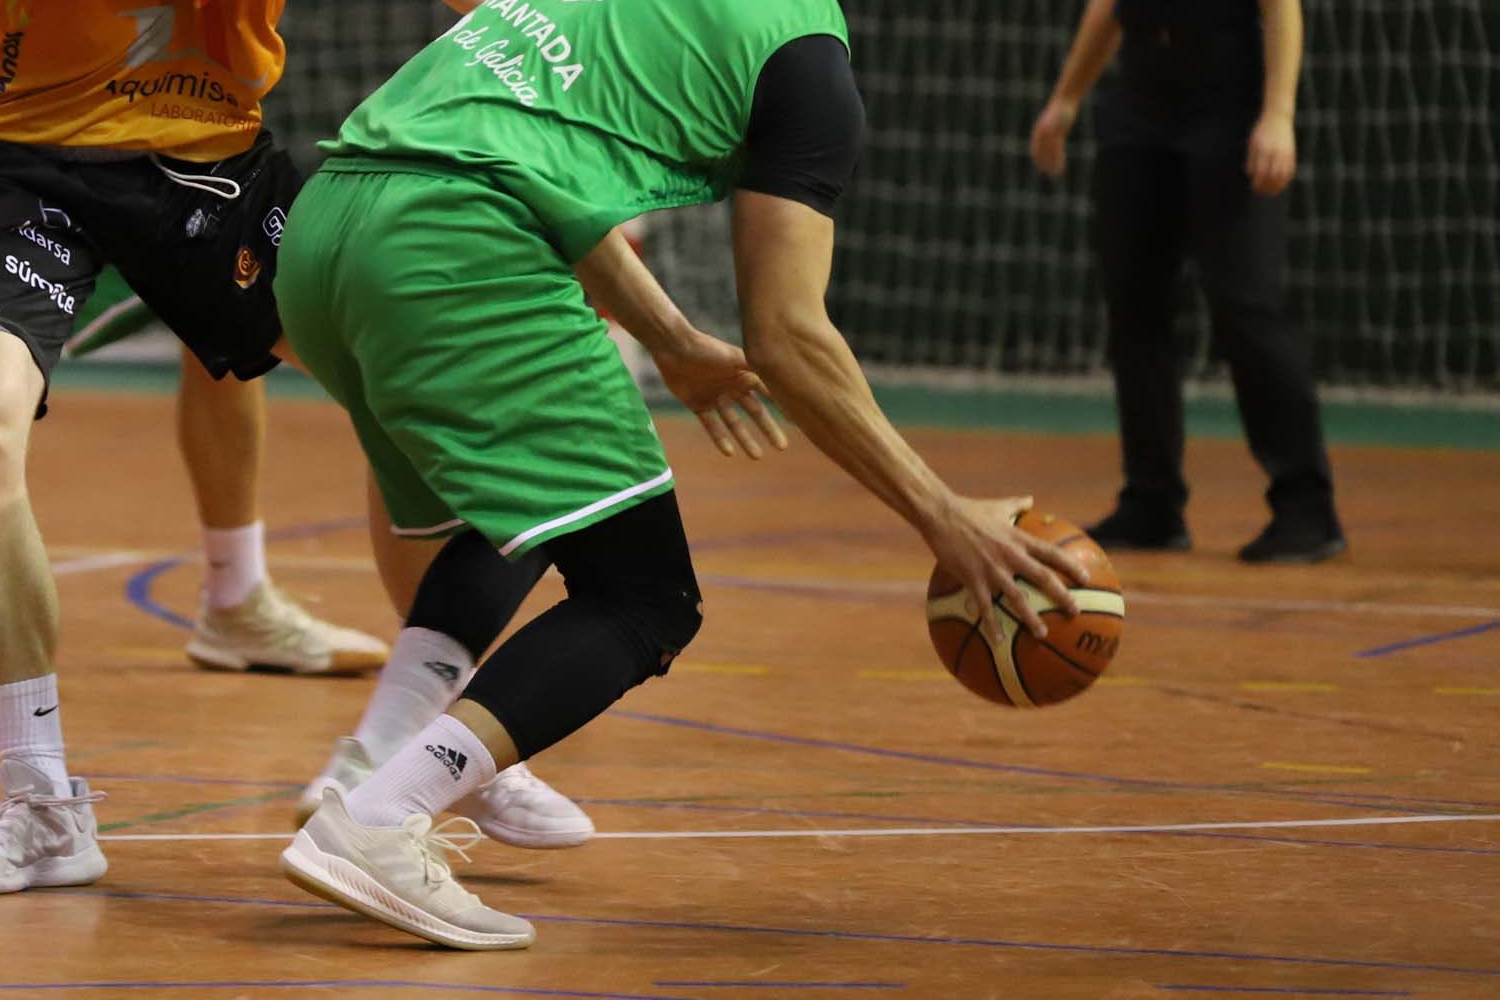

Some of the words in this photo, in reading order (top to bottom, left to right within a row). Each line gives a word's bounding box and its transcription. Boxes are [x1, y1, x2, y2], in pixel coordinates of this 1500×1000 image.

[453, 26, 489, 51] de
[465, 40, 539, 107] Galicia
[425, 744, 462, 781] adidas
